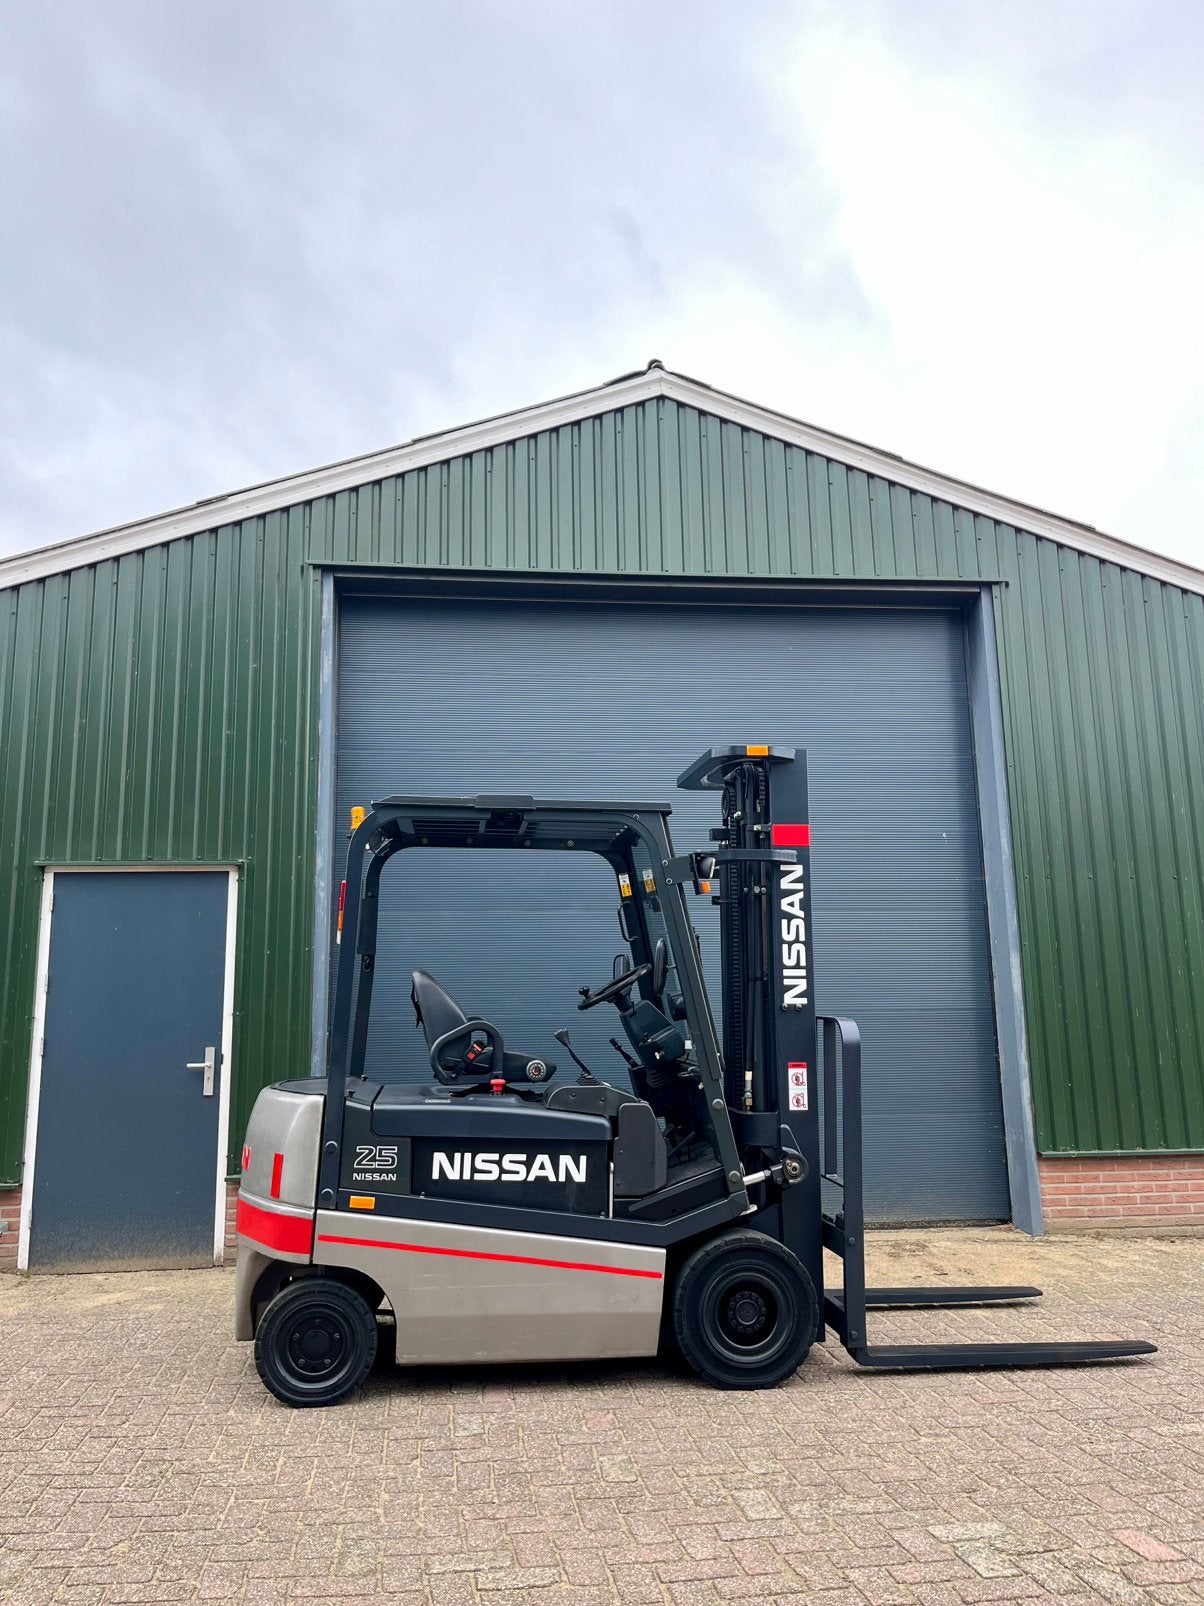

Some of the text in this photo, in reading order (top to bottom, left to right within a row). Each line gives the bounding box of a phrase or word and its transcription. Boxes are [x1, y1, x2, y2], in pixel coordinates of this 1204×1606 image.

[780, 864, 807, 1005] NISSAN
[353, 1145, 398, 1169] 25
[431, 1152, 587, 1183] NISSAN
[352, 1172, 397, 1181] NISSAN
